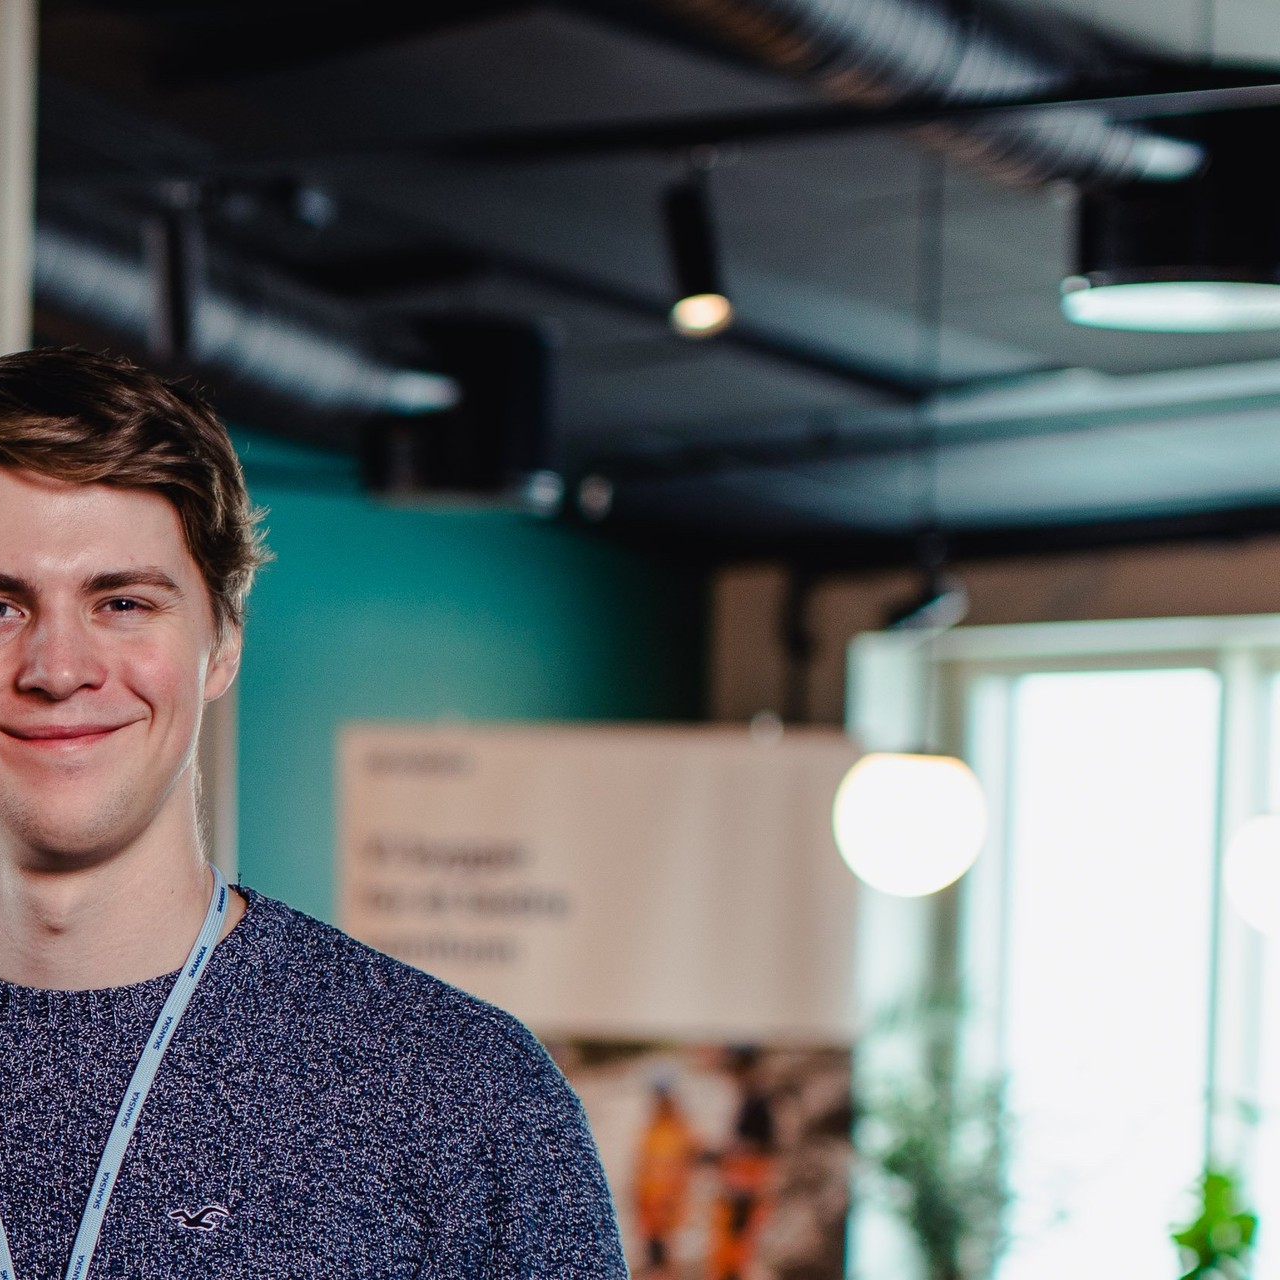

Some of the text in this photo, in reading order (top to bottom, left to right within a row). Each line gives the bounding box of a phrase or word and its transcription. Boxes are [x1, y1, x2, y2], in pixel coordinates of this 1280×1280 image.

[188, 946, 208, 978] SKANSKA
[153, 1016, 173, 1051] SKANSKA
[120, 1091, 140, 1128] SKANSKA
[92, 1171, 111, 1209] SKANSKA
